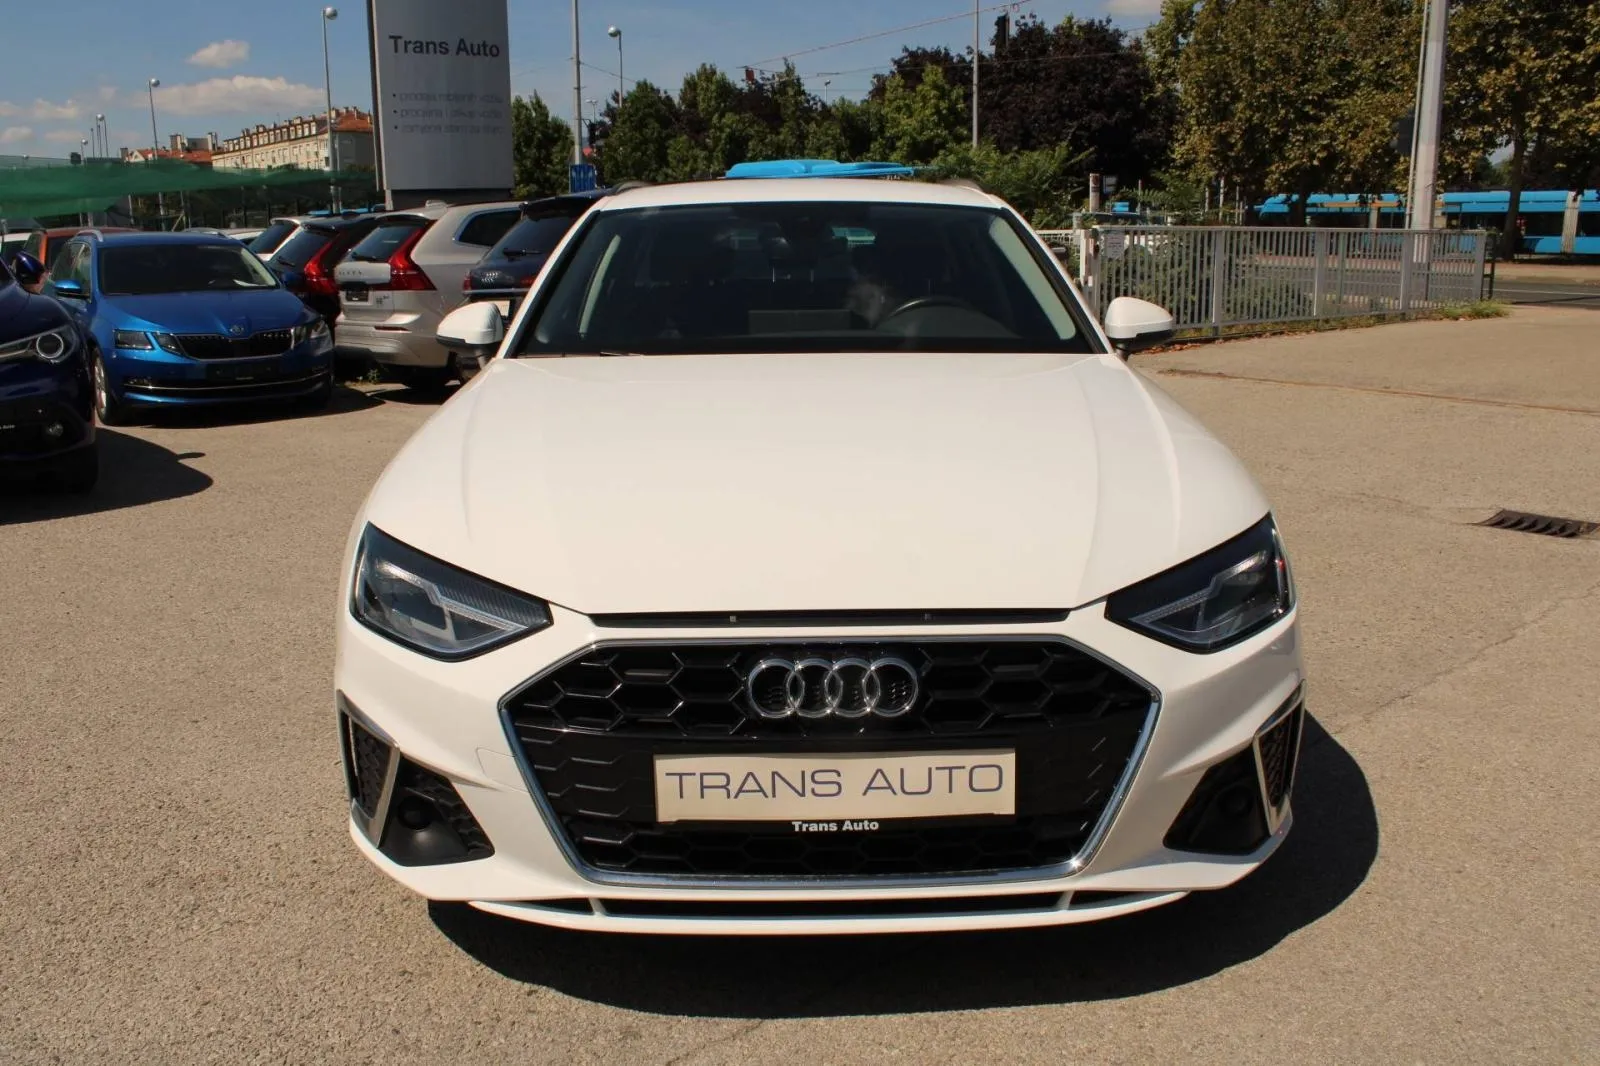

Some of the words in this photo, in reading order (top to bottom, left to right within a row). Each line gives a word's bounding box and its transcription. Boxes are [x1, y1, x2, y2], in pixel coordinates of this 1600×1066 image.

[389, 35, 449, 55] Trans
[455, 38, 500, 57] Auto
[665, 768, 842, 799] TRANS
[862, 764, 1003, 796] AUTO
[792, 821, 838, 832] Trans
[842, 820, 879, 831] Auto
